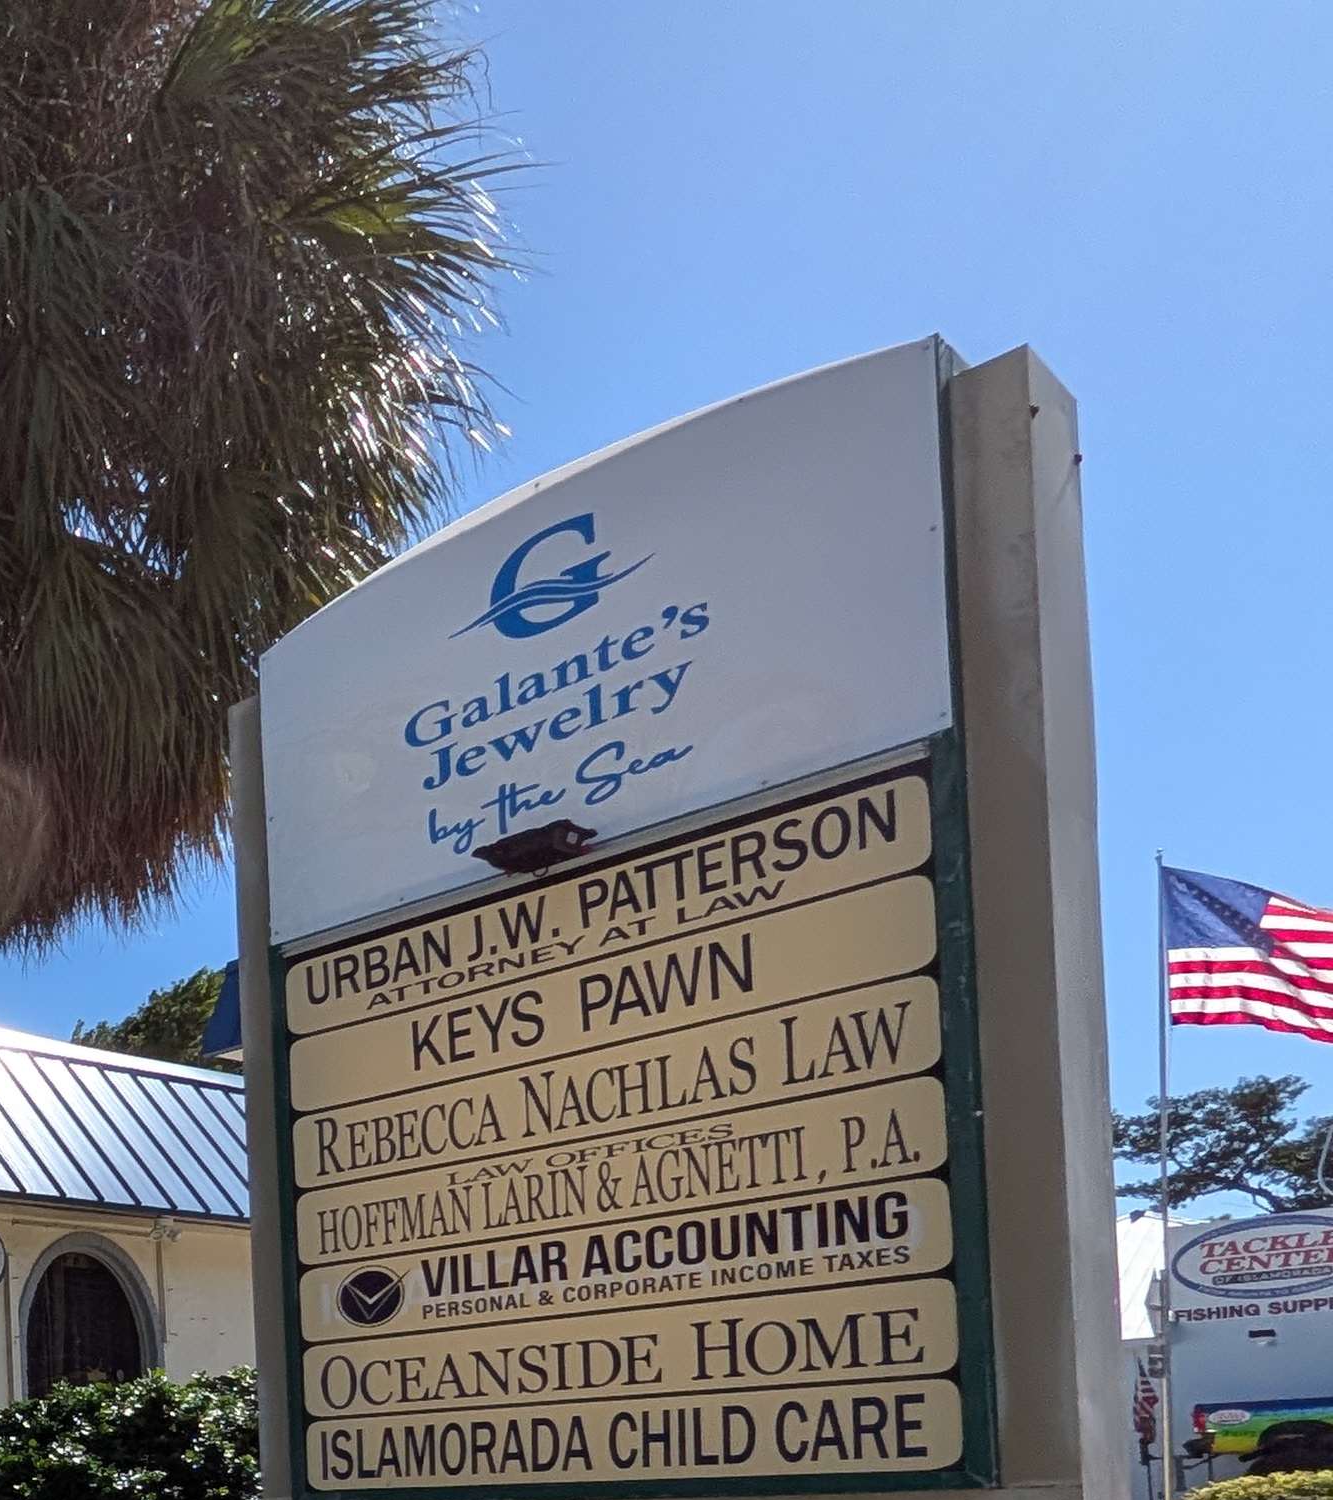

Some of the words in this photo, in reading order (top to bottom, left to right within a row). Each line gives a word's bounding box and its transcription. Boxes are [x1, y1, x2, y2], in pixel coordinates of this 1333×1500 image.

[404, 602, 710, 748] Galante's
[422, 659, 693, 790] Jewelry
[428, 808, 485, 855] by
[480, 784, 566, 835] the
[575, 741, 694, 805] Sea
[306, 924, 453, 1005] URBAN
[467, 895, 561, 962] J.W.
[578, 789, 896, 929] PATTERSON
[366, 934, 586, 1012] ATTORNEY
[599, 916, 656, 948] AT
[677, 879, 786, 925] LAW
[411, 990, 545, 1072] KEYS
[579, 932, 753, 1033] PAWN
[314, 1094, 507, 1177] REBECCA
[518, 1036, 757, 1138] NACHLAS
[780, 1000, 912, 1087] LAW
[317, 1185, 474, 1255] HOFFMAN
[481, 1164, 588, 1230] LARIN
[596, 1160, 623, 1213] &
[840, 1108, 921, 1174] P.A.
[446, 1158, 534, 1186] LAW
[545, 1122, 734, 1168] OFFICES
[421, 1239, 568, 1298] VILLAR
[582, 1191, 910, 1279] ACCOUNTING
[422, 1291, 531, 1320] PERSONAL
[538, 1289, 554, 1305] &
[562, 1271, 703, 1304] CORPORATE
[711, 1257, 814, 1287] INCOME
[826, 1245, 911, 1274] TAXES
[320, 1333, 663, 1410] OCEANSIDE
[690, 1307, 926, 1381] HOME
[1175, 1303, 1261, 1322] FISHING
[320, 1415, 593, 1481] ISLAMORADA
[608, 1405, 757, 1470] CHILD
[775, 1393, 929, 1463] CARE
